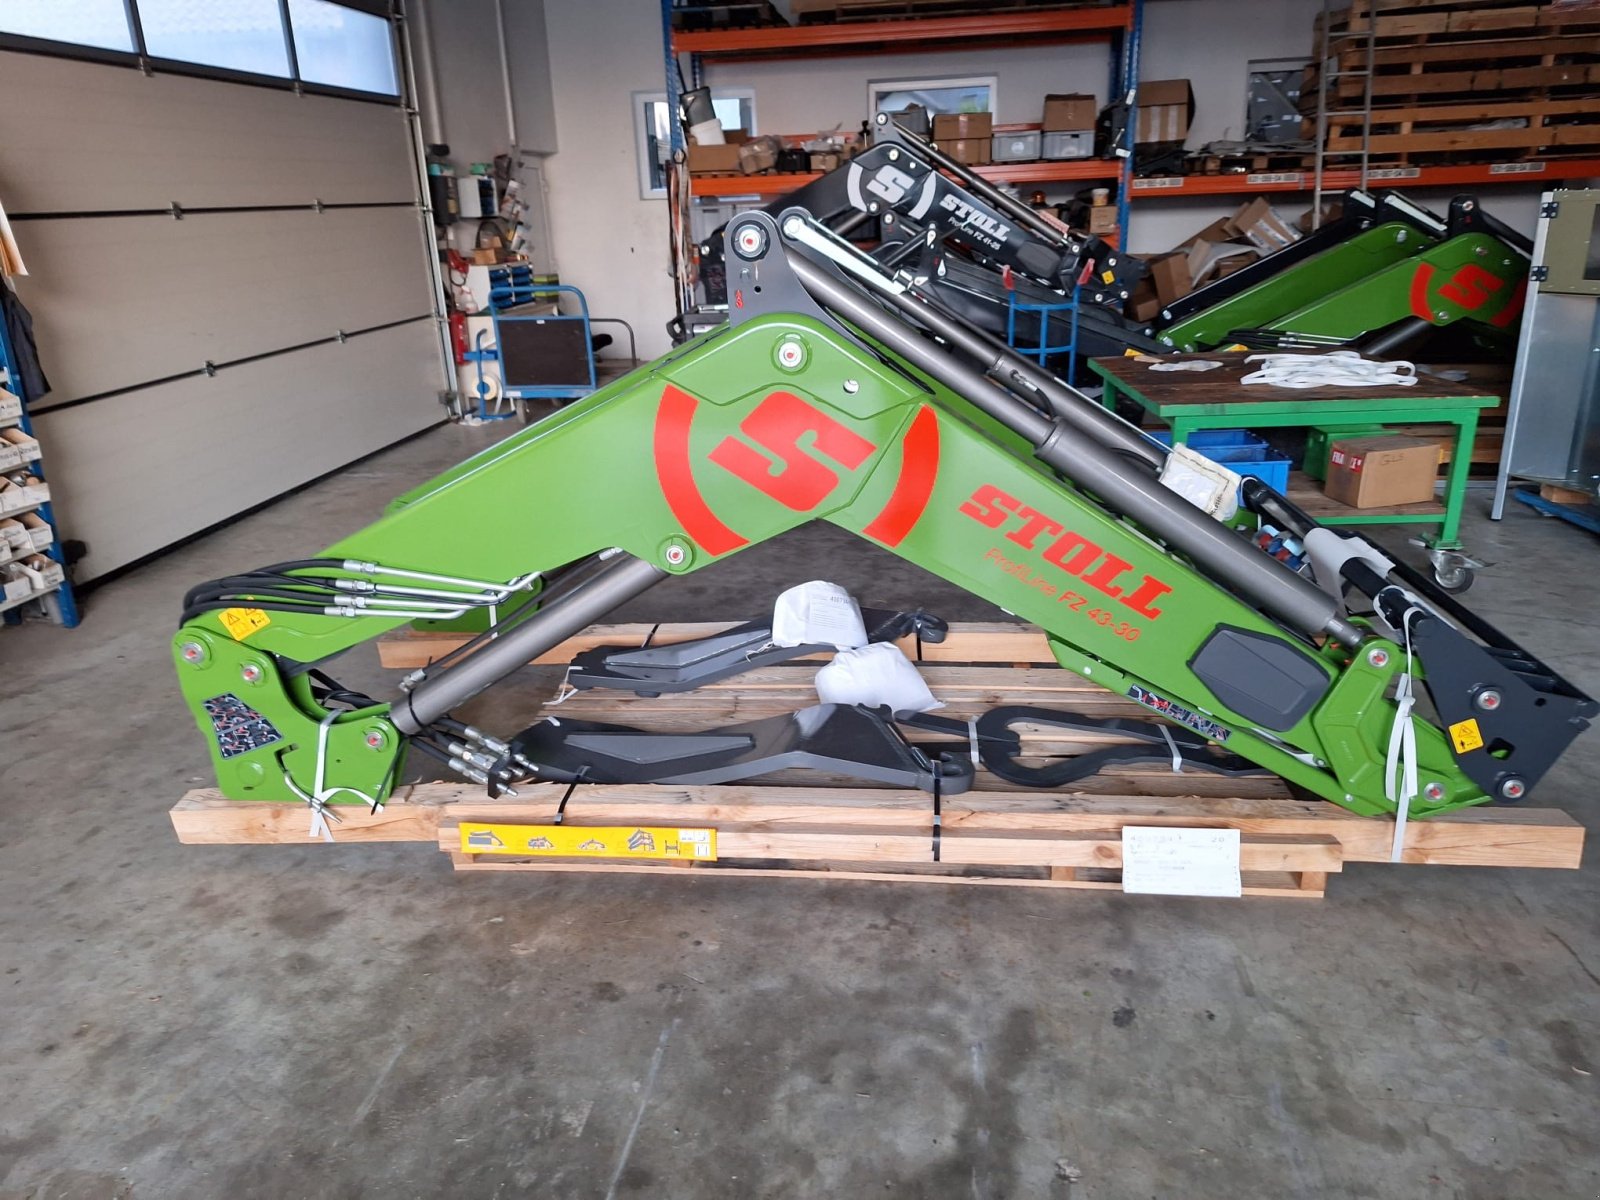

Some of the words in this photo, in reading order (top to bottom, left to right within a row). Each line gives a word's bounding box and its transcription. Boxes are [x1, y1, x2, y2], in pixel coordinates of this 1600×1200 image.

[867, 165, 915, 203] S
[1436, 263, 1505, 311] S
[707, 390, 878, 512] S
[959, 483, 1174, 621] STOLL
[983, 547, 1057, 597] ProfiLine
[1057, 589, 1088, 612] FZ
[1086, 608, 1141, 642] 43-30
